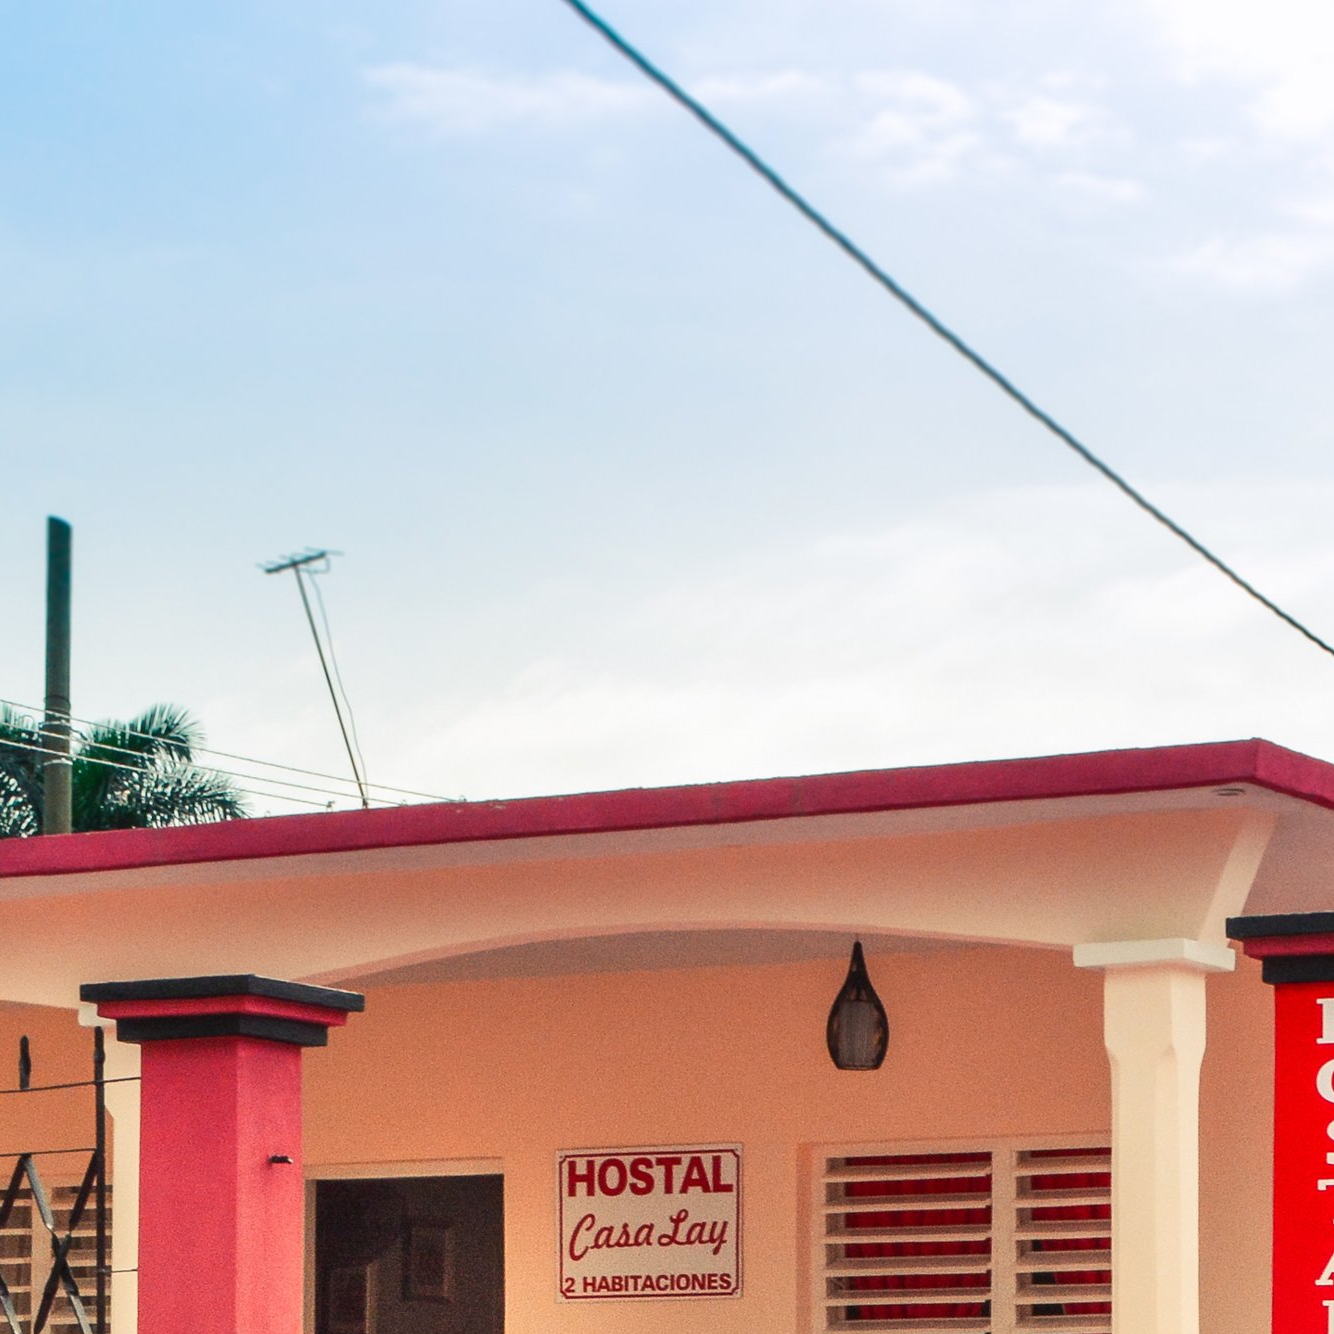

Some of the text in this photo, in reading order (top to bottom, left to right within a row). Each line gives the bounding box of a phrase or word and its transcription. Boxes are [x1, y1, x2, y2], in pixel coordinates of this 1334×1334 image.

[567, 1155, 734, 1198] HOSTAL
[569, 1208, 729, 1261] Casa Lay
[564, 1273, 733, 1293] 2 HABITACIONES
